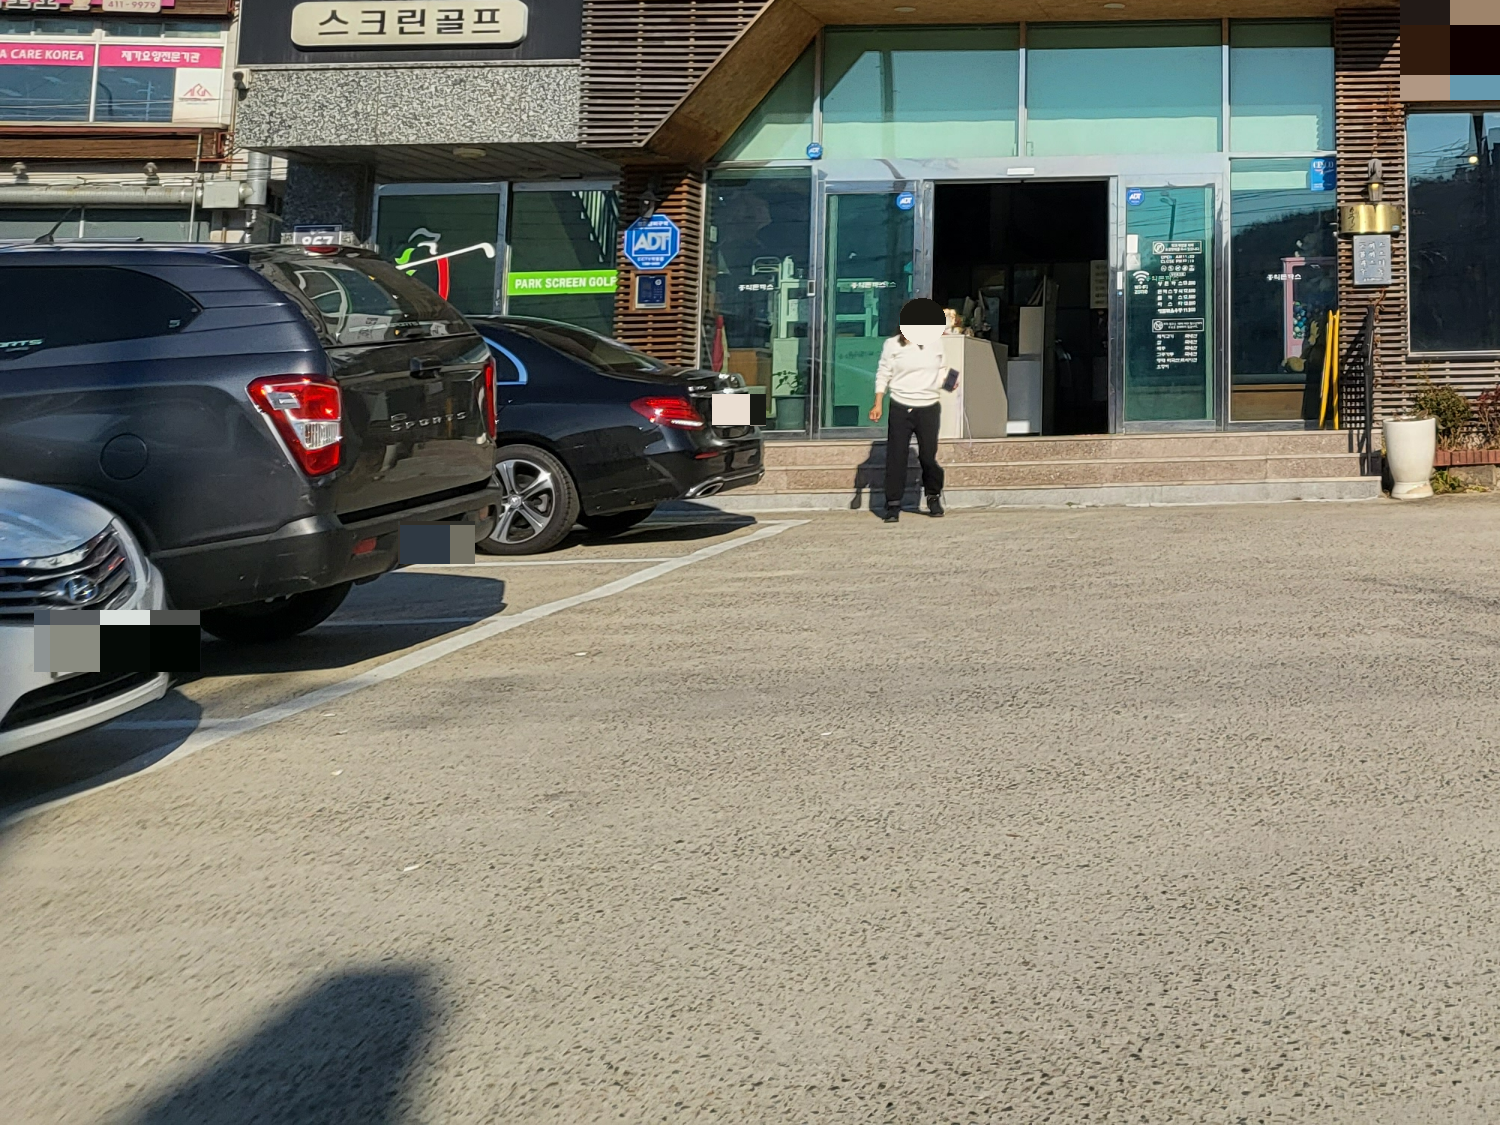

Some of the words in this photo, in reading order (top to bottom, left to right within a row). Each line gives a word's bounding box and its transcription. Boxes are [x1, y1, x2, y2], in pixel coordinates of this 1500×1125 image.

[107, 1, 157, 9] 411-9979
[318, 8, 501, 35] 스크린골프
[11, 49, 43, 59] CARE
[45, 50, 84, 61] KOREA
[121, 50, 201, 63] 재가요양전문기관
[633, 232, 671, 251] ADT
[515, 278, 542, 289] PARK
[545, 277, 586, 288] SCREEN
[588, 276, 619, 287] GOLF
[391, 412, 466, 431] SPORTS
